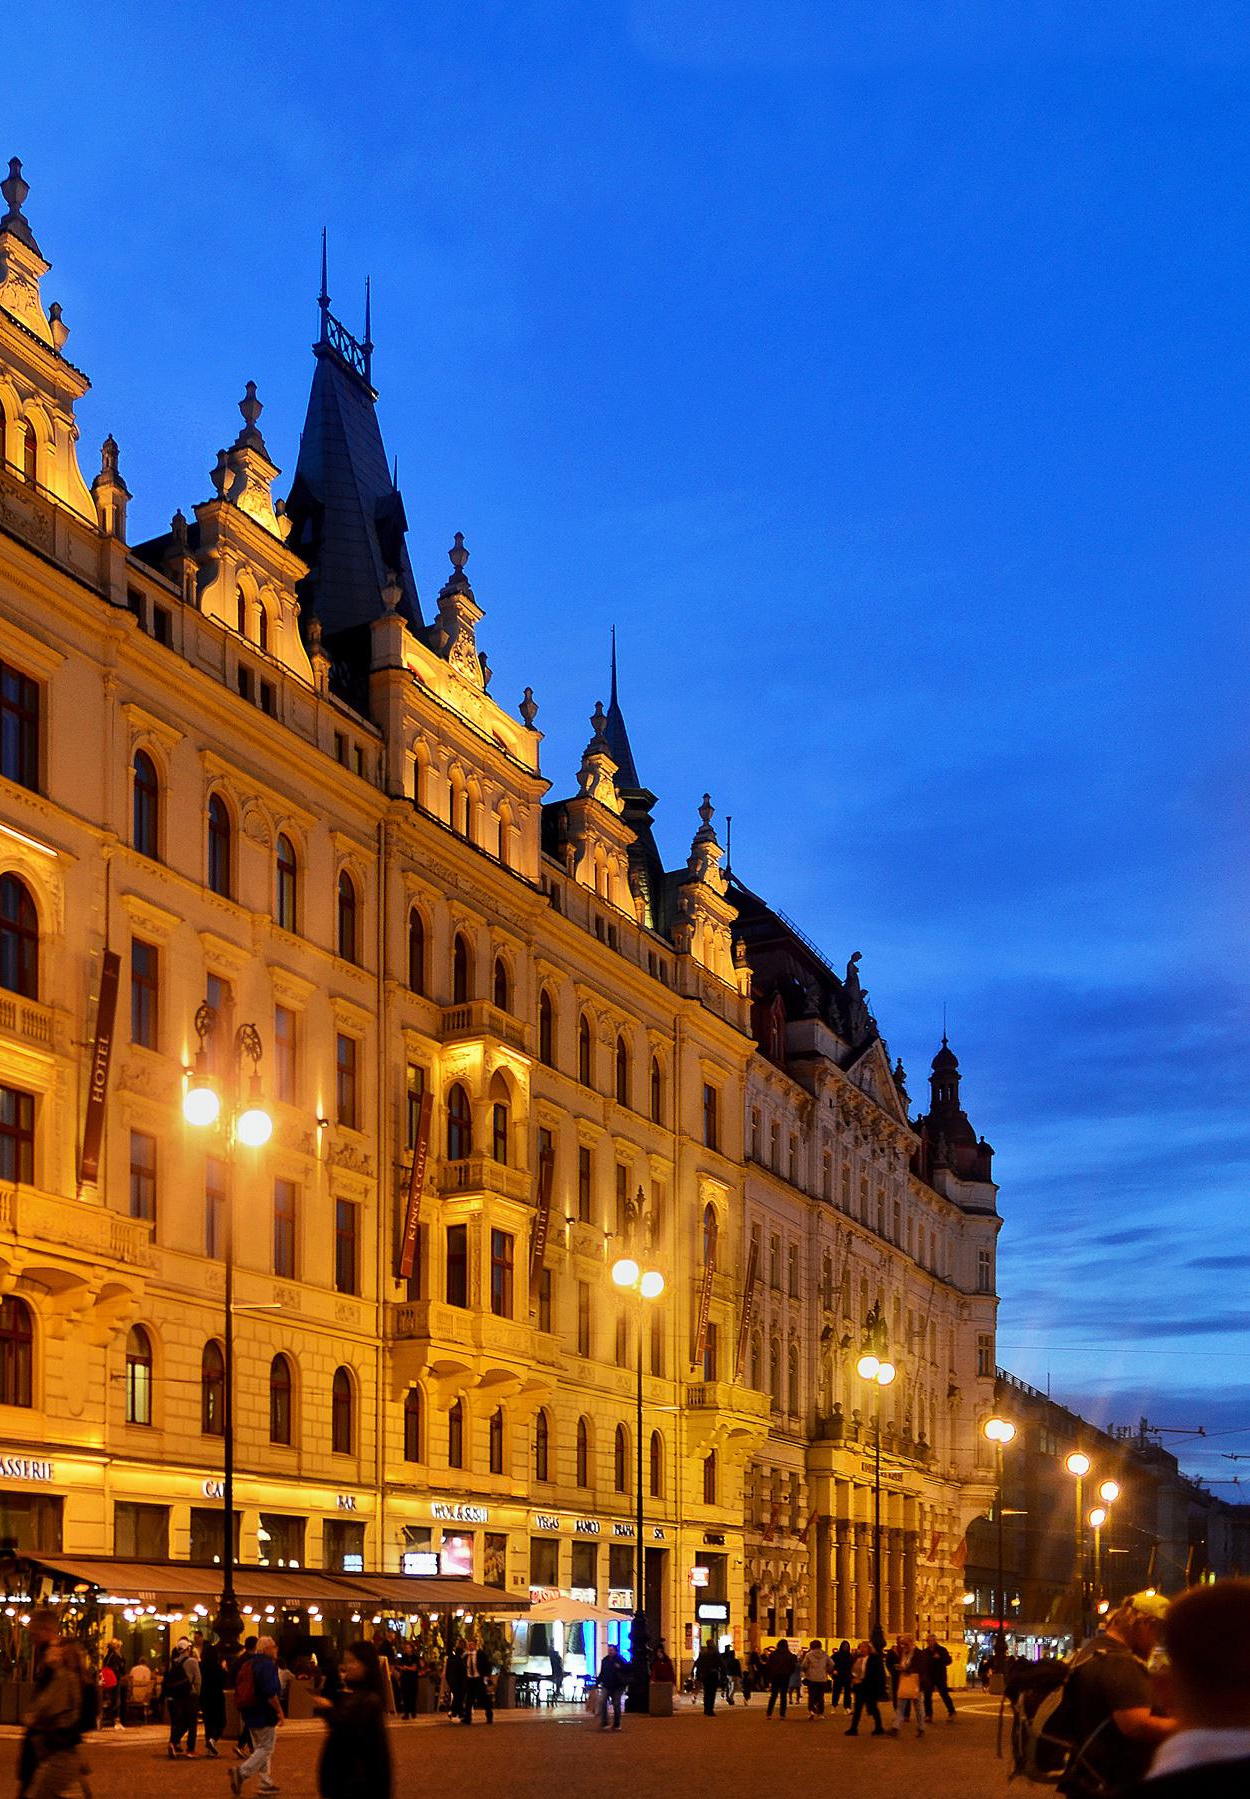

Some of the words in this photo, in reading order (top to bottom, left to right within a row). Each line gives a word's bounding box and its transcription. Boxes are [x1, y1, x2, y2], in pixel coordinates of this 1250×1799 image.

[92, 1034, 110, 1104] HOTEL
[408, 1198, 421, 1242] KINGS
[416, 1140, 428, 1187] COURT
[535, 1207, 549, 1257] HOTEL
[336, 1494, 357, 1511] BAR
